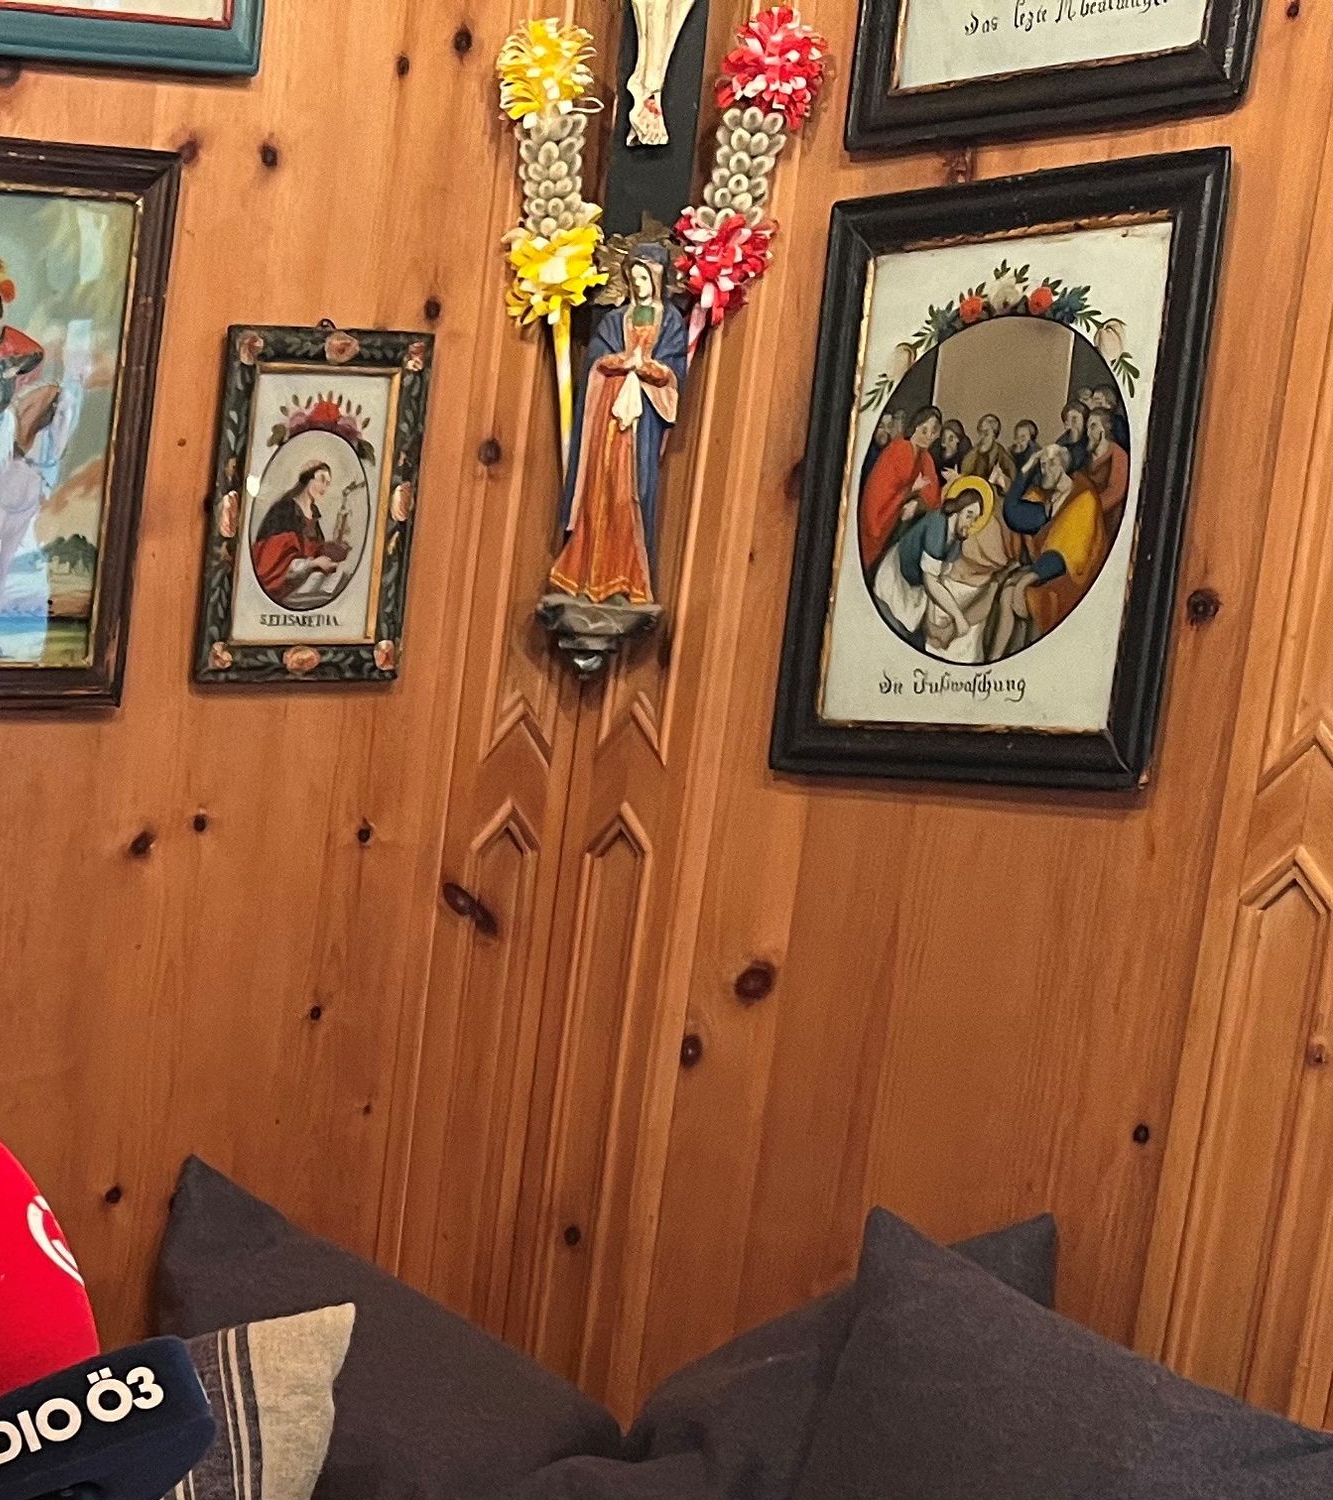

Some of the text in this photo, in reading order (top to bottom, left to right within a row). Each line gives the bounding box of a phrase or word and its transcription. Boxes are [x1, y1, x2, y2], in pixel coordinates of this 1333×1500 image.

[965, 12, 998, 36] Das
[879, 670, 903, 695] Die
[86, 1367, 164, 1423] Ö3
